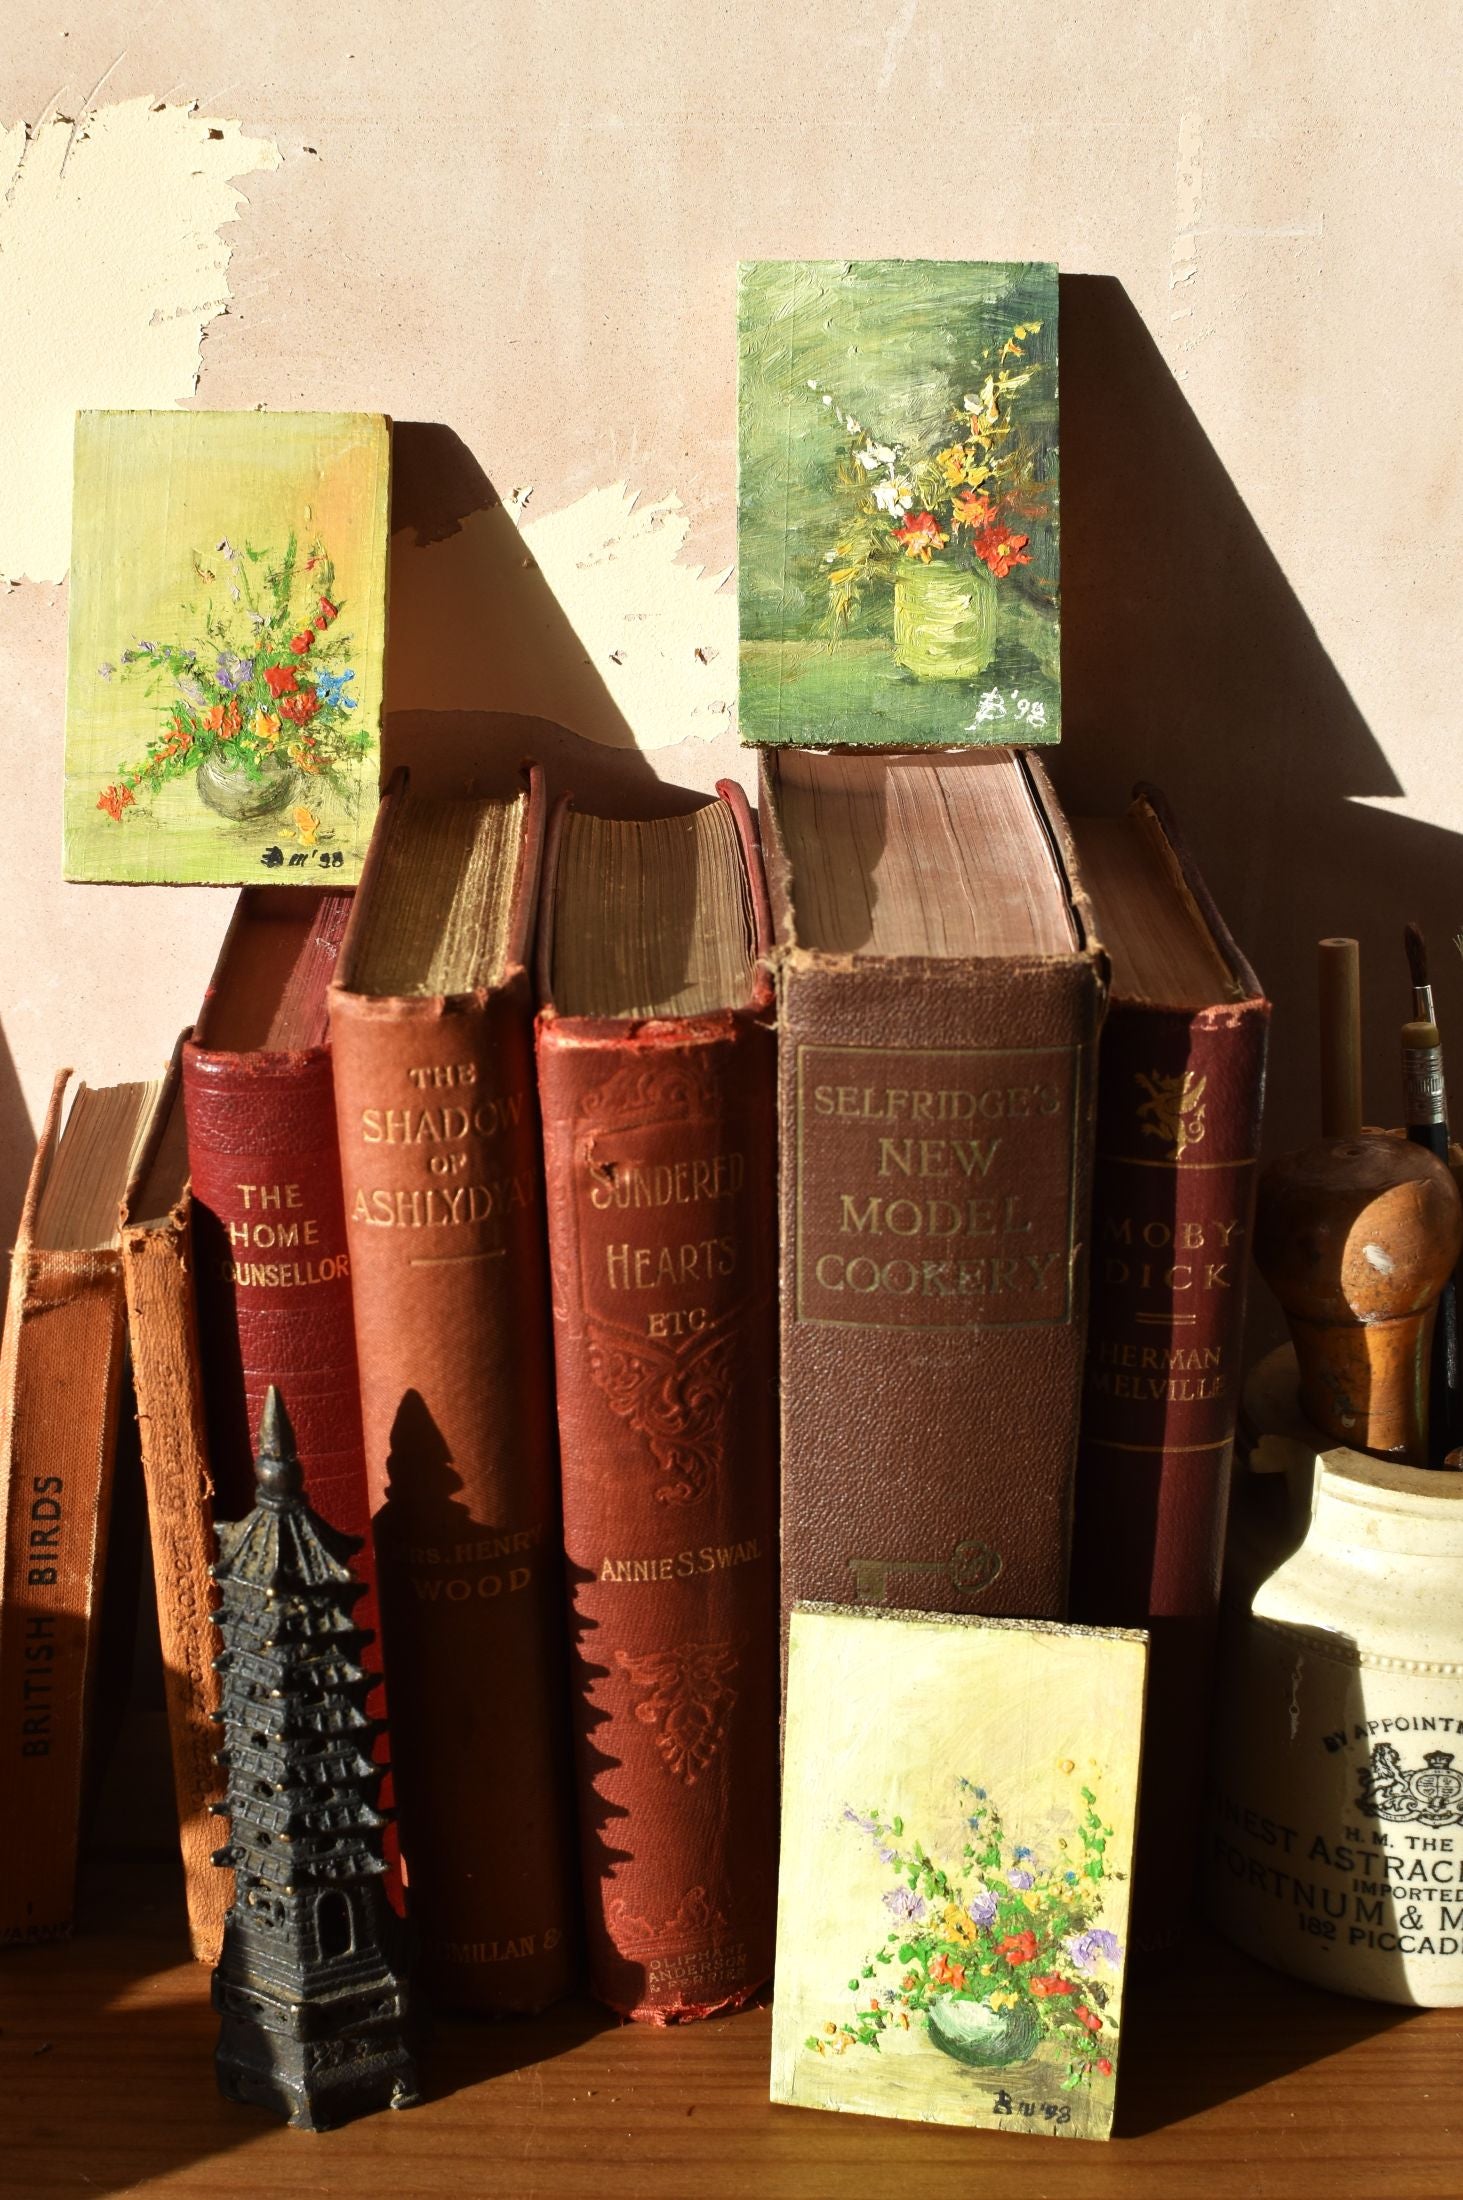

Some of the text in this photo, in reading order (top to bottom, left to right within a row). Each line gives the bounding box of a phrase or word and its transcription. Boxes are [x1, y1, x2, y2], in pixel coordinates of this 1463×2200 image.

[408, 1062, 477, 1090] THE
[813, 1083, 1061, 1120] SELFRIDGE'S
[361, 1092, 524, 1145] SHADOW
[430, 1153, 468, 1175] OF
[877, 1137, 1002, 1178] NEW
[236, 1184, 304, 1210] THE
[590, 1152, 745, 1210] SUNDERED
[839, 1194, 1032, 1237] MODEL
[229, 1219, 320, 1249] HOME
[1104, 1217, 1240, 1249] MOBY
[606, 1236, 738, 1290] HEARTS
[815, 1252, 1061, 1297] COOKERY
[1104, 1259, 1232, 1291] DICK
[647, 1307, 716, 1338] ETC.
[1099, 1342, 1223, 1371] HERMAN
[1089, 1372, 1226, 1401] MELVILLE
[408, 1567, 532, 1602] WOOD
[600, 1556, 673, 1582] ANNIE
[21, 1475, 64, 1758] BRITISH BIRDS
[1214, 1791, 1463, 1883] INEST ASTRAC
[1404, 1835, 1454, 1852] THE
[1213, 1831, 1384, 1926] FORTNUM
[1400, 1905, 1423, 1931] &
[1352, 1878, 1463, 1903] IMPORTED
[1297, 1913, 1336, 1941] 182
[650, 1943, 744, 1970] OLIPHANT
